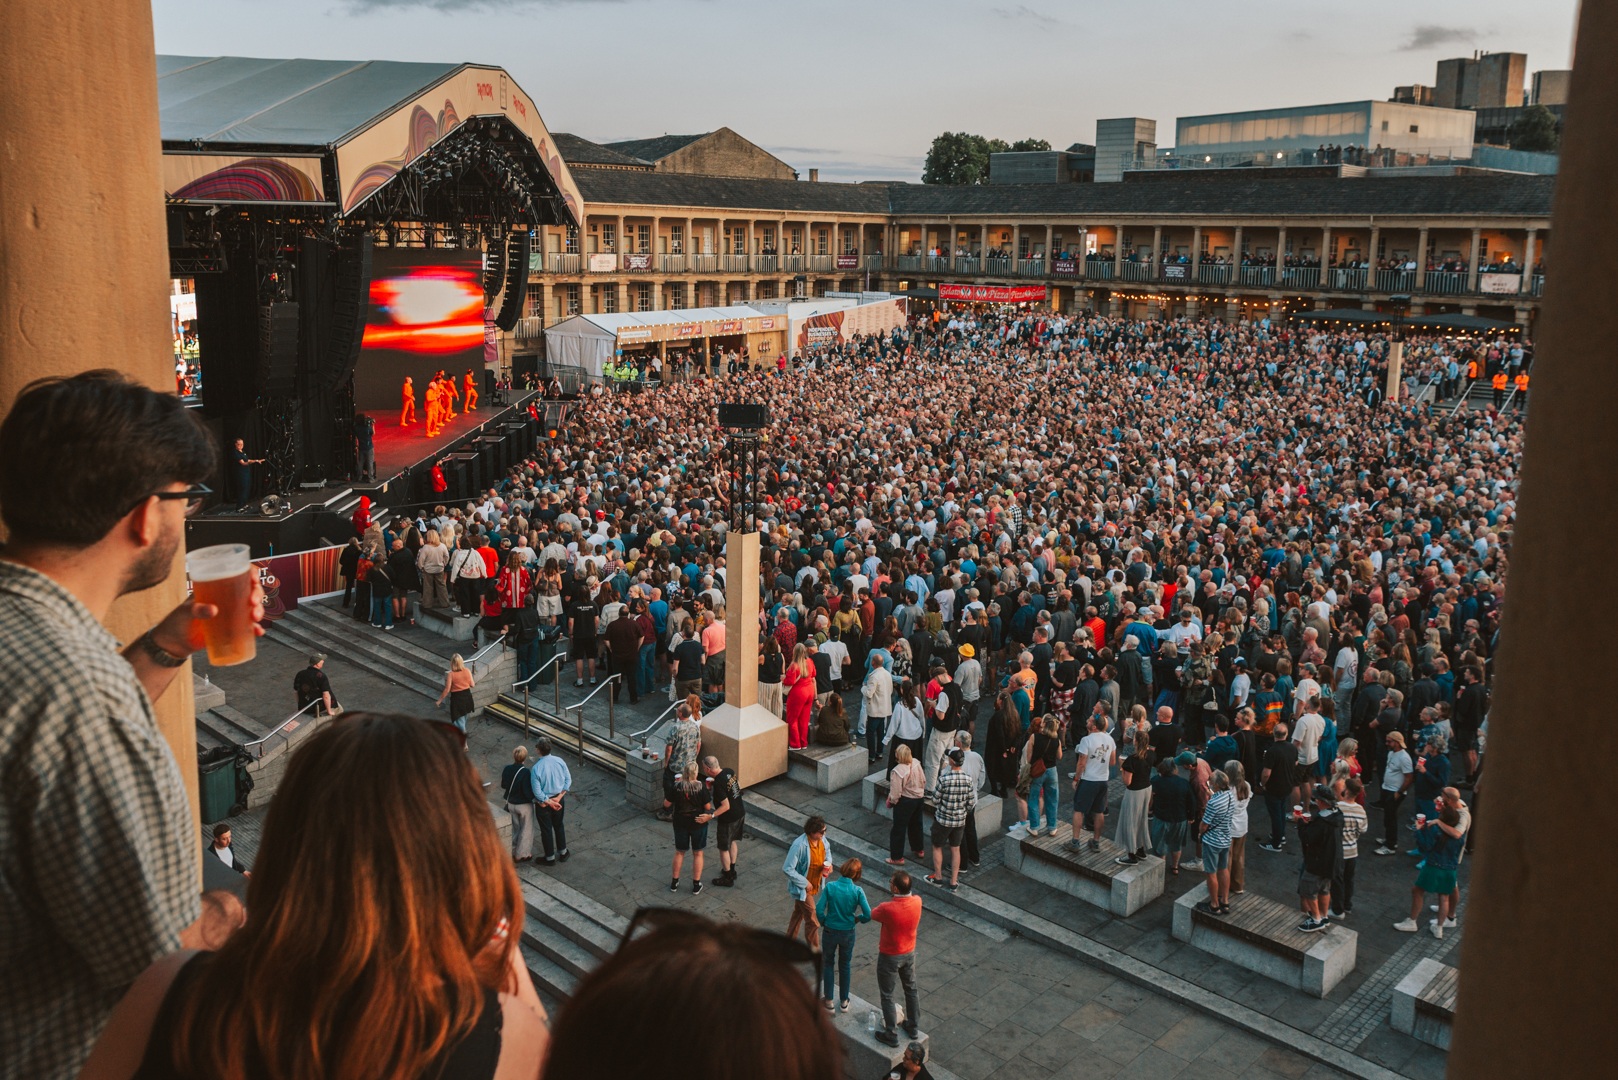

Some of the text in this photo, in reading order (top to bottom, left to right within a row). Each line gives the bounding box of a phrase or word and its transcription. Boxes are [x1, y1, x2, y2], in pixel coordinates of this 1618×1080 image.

[940, 287, 961, 297] Gelato
[988, 289, 1009, 299] Pizza
[1010, 287, 1046, 299] Pizza Gelato
[682, 326, 692, 334] BAR
[724, 323, 734, 331] BAR
[259, 575, 276, 585] TO
